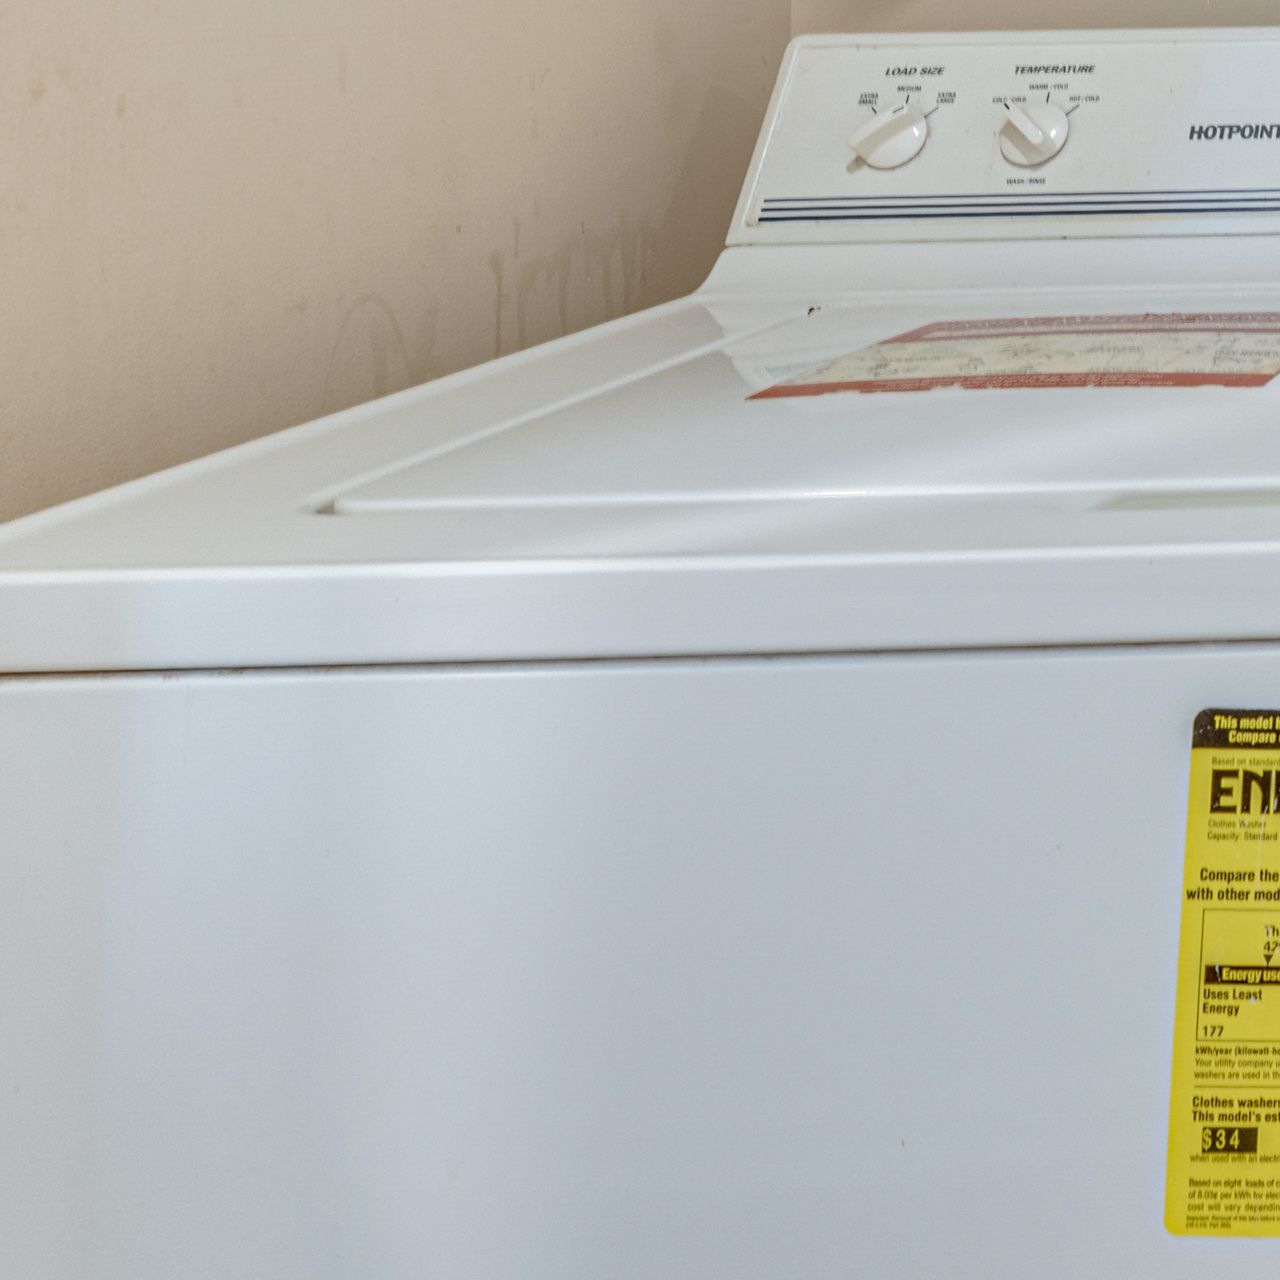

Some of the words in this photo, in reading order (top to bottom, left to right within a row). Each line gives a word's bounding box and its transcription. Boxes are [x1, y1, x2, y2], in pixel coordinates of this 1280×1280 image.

[885, 67, 917, 76] LOAD
[920, 67, 945, 75] SIZE
[1015, 65, 1095, 74] TEMPERATURE
[1214, 715, 1237, 729] This
[1240, 716, 1273, 730] model
[1228, 730, 1276, 745] Compare
[1200, 868, 1255, 884] Compare
[1259, 869, 1279, 882] the
[1186, 888, 1213, 900] with
[1217, 888, 1250, 900] other
[1222, 968, 1261, 983] Energy
[1204, 989, 1229, 1000] Uses
[1233, 989, 1262, 1000] Least
[1203, 1003, 1240, 1016] Energy
[1203, 1026, 1224, 1037] 177
[1192, 1096, 1234, 1108] Clothes
[1192, 1110, 1214, 1122] This
[1218, 1111, 1261, 1122] model's
[1202, 1129, 1240, 1150] $34
